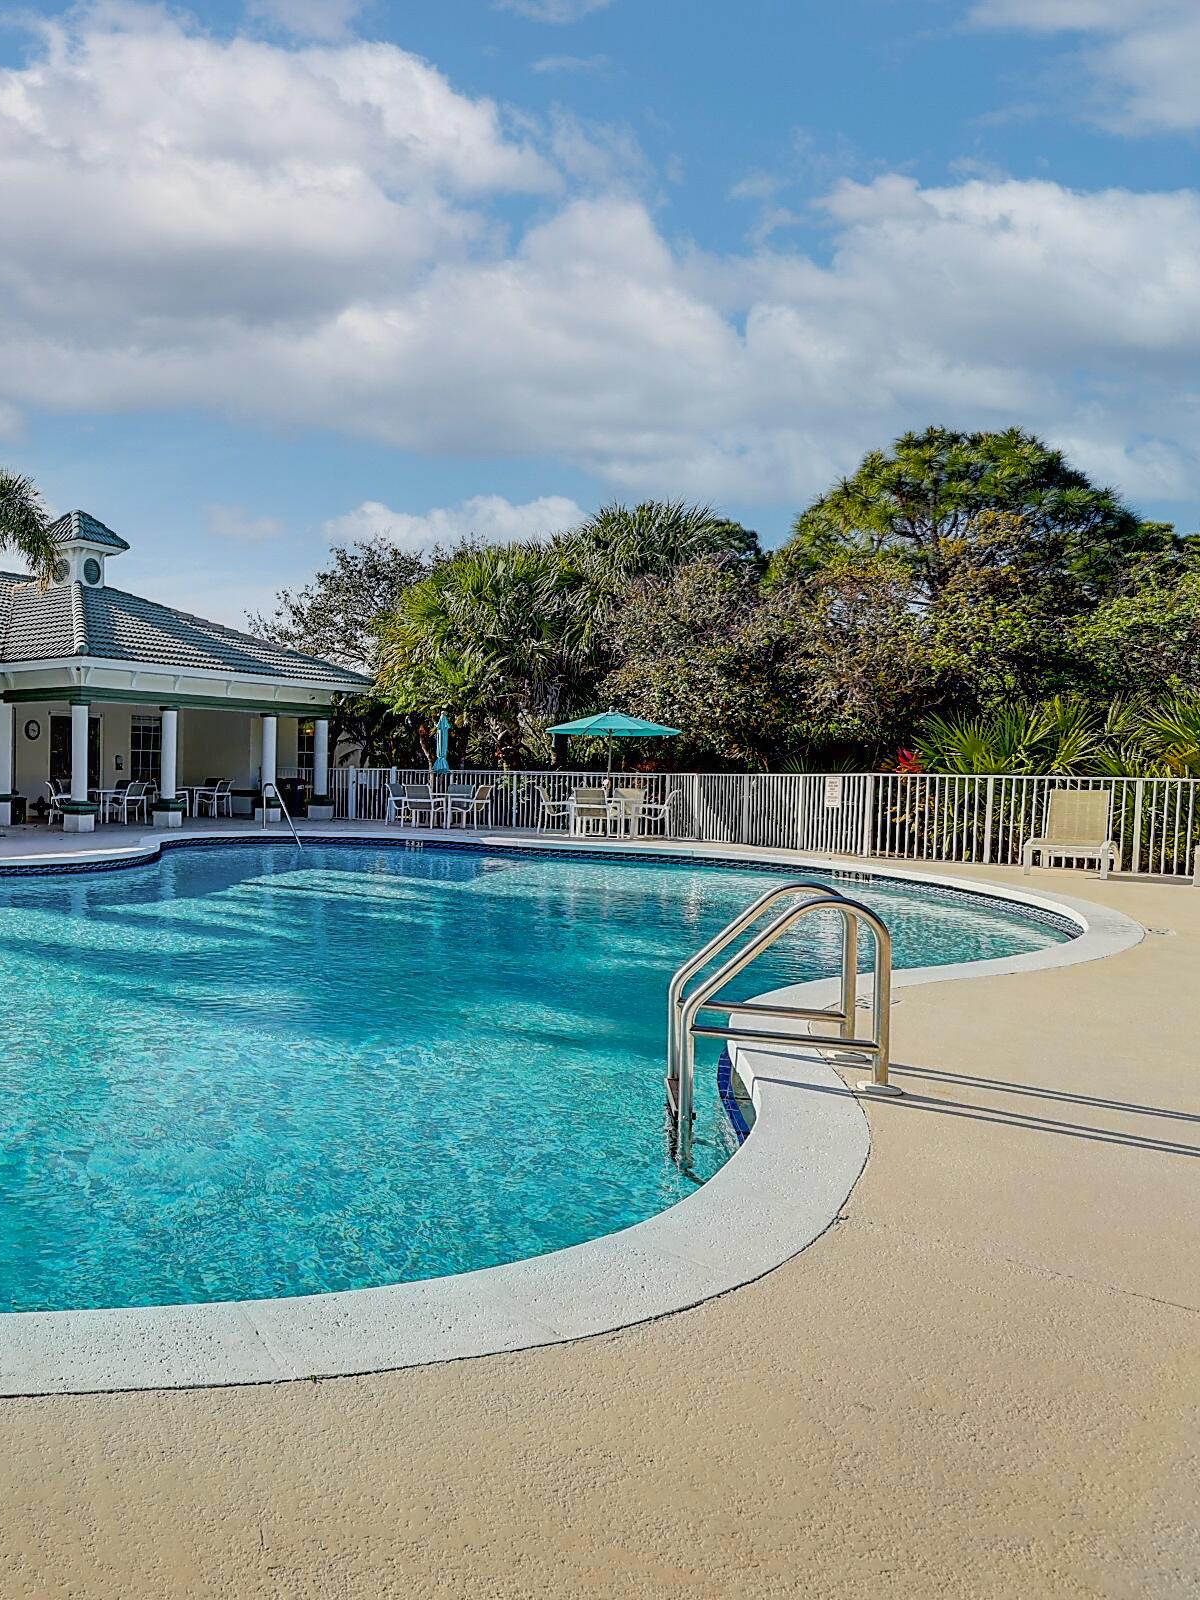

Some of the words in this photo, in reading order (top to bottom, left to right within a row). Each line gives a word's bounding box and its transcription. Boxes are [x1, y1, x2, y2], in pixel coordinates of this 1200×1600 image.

[834, 870, 840, 878] 3
[843, 871, 852, 879] FT
[855, 872, 860, 881] 6
[862, 873, 870, 882] IN
